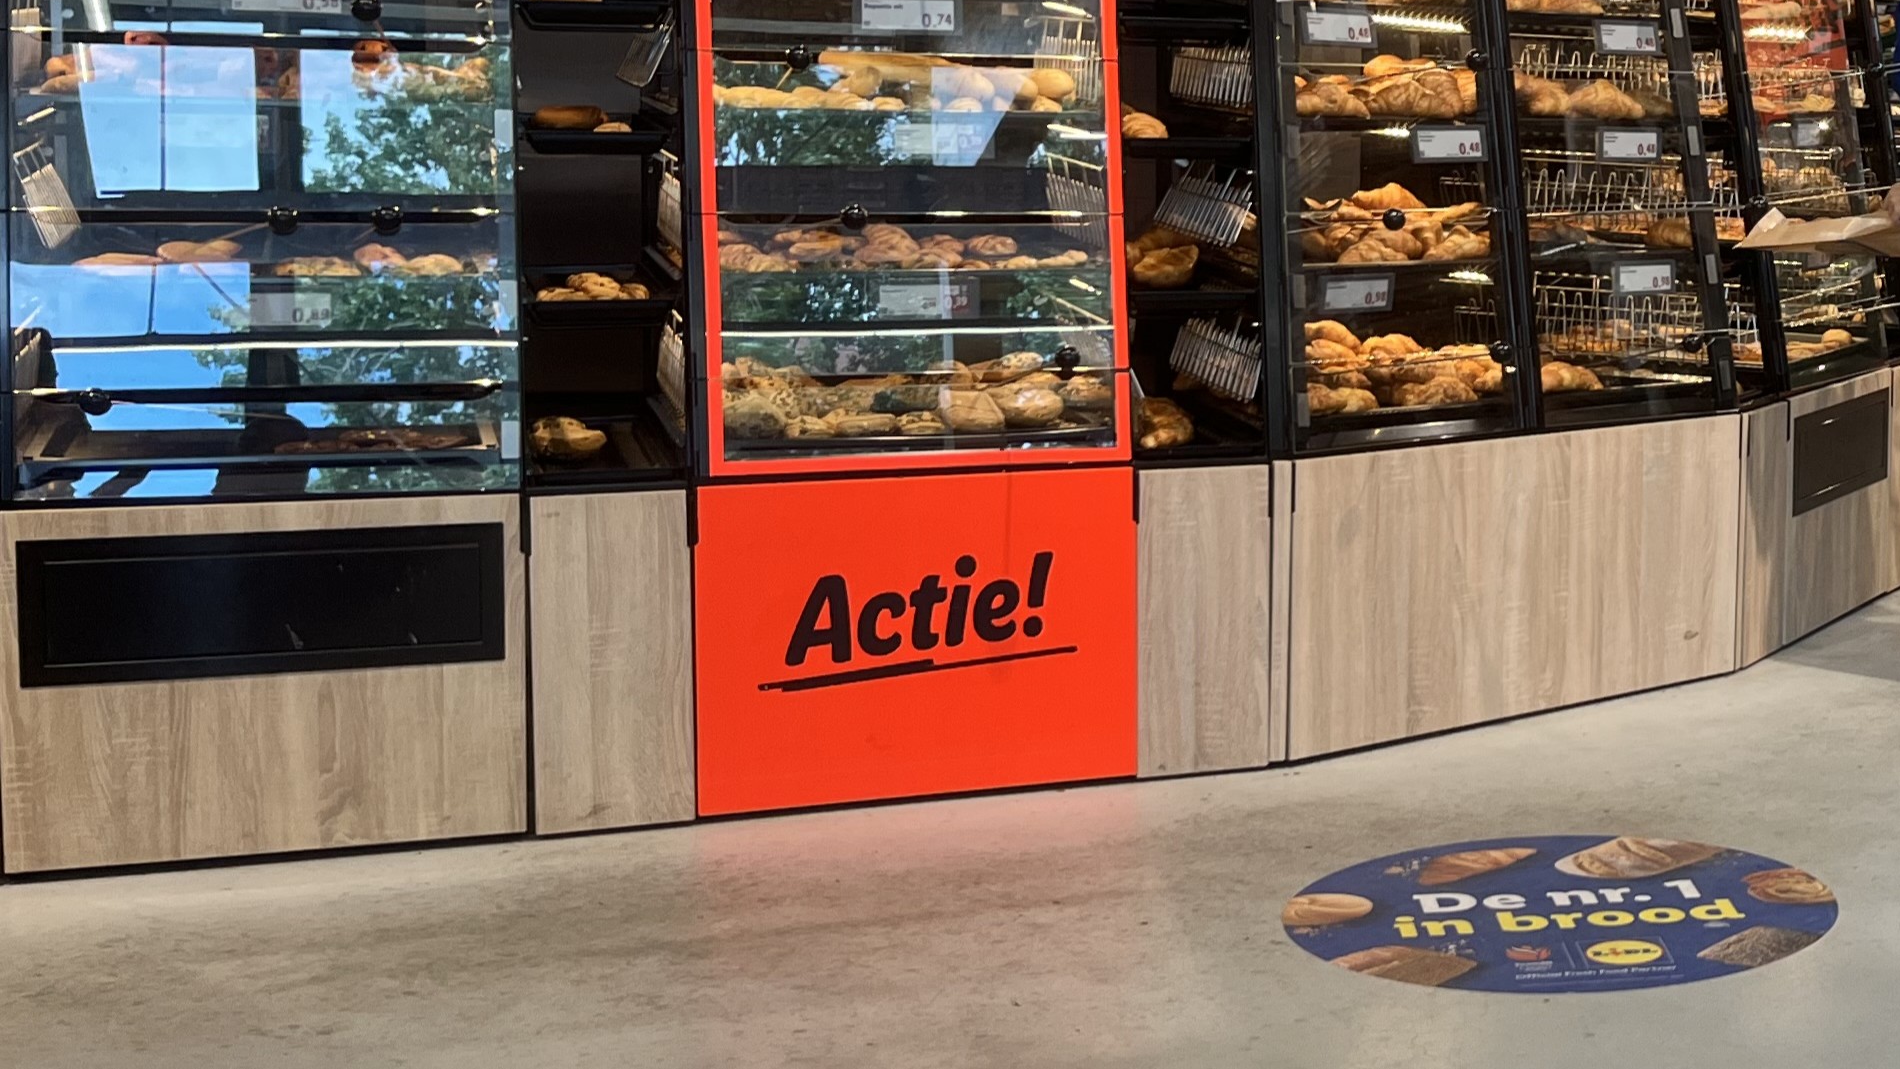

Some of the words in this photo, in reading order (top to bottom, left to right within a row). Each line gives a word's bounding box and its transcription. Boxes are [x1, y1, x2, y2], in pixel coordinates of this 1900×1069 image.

[784, 551, 1054, 667] Actie!
[1412, 892, 1526, 915] De
[1546, 883, 1653, 907] nr.
[1663, 878, 1702, 899] 1
[1393, 914, 1475, 939] in
[1494, 898, 1746, 935] brood
